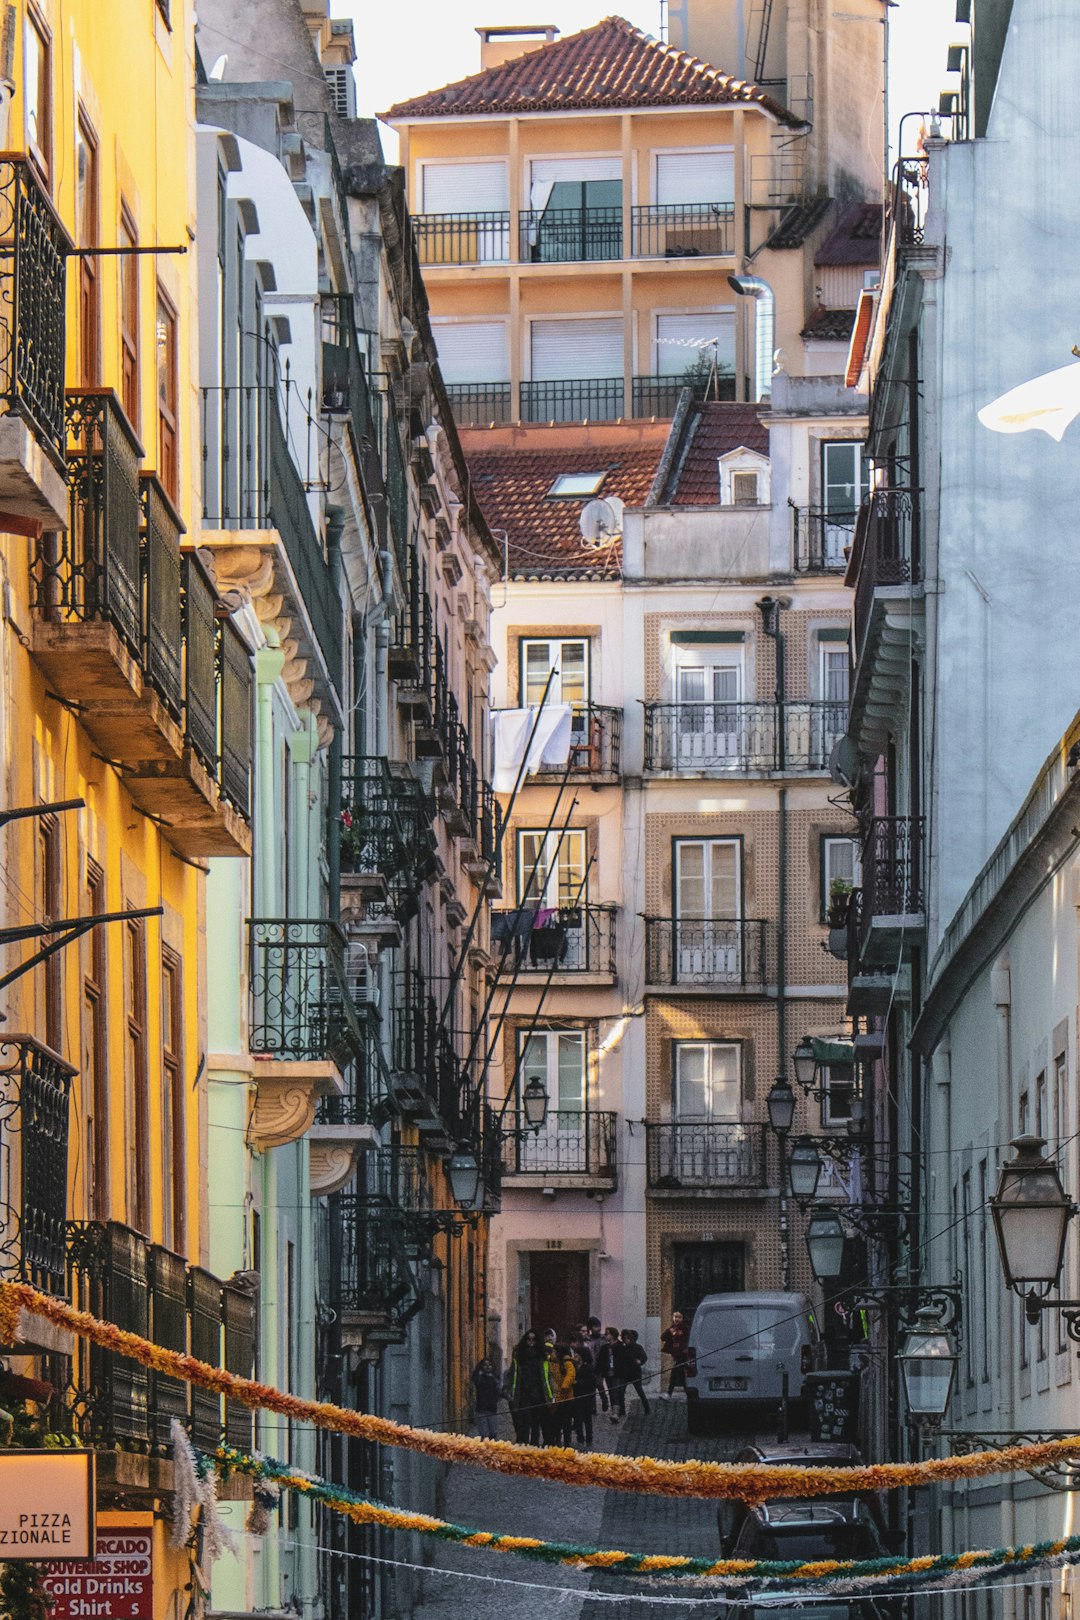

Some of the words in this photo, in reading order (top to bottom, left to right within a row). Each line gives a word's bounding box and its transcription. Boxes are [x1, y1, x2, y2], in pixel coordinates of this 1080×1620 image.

[19, 1513, 71, 1528] PIZZA
[0, 1530, 71, 1544] ZIONALE
[113, 1560, 148, 1575] SHOP
[43, 1579, 81, 1594] Cold
[86, 1578, 144, 1594] Drinks
[69, 1599, 112, 1616] Shirt
